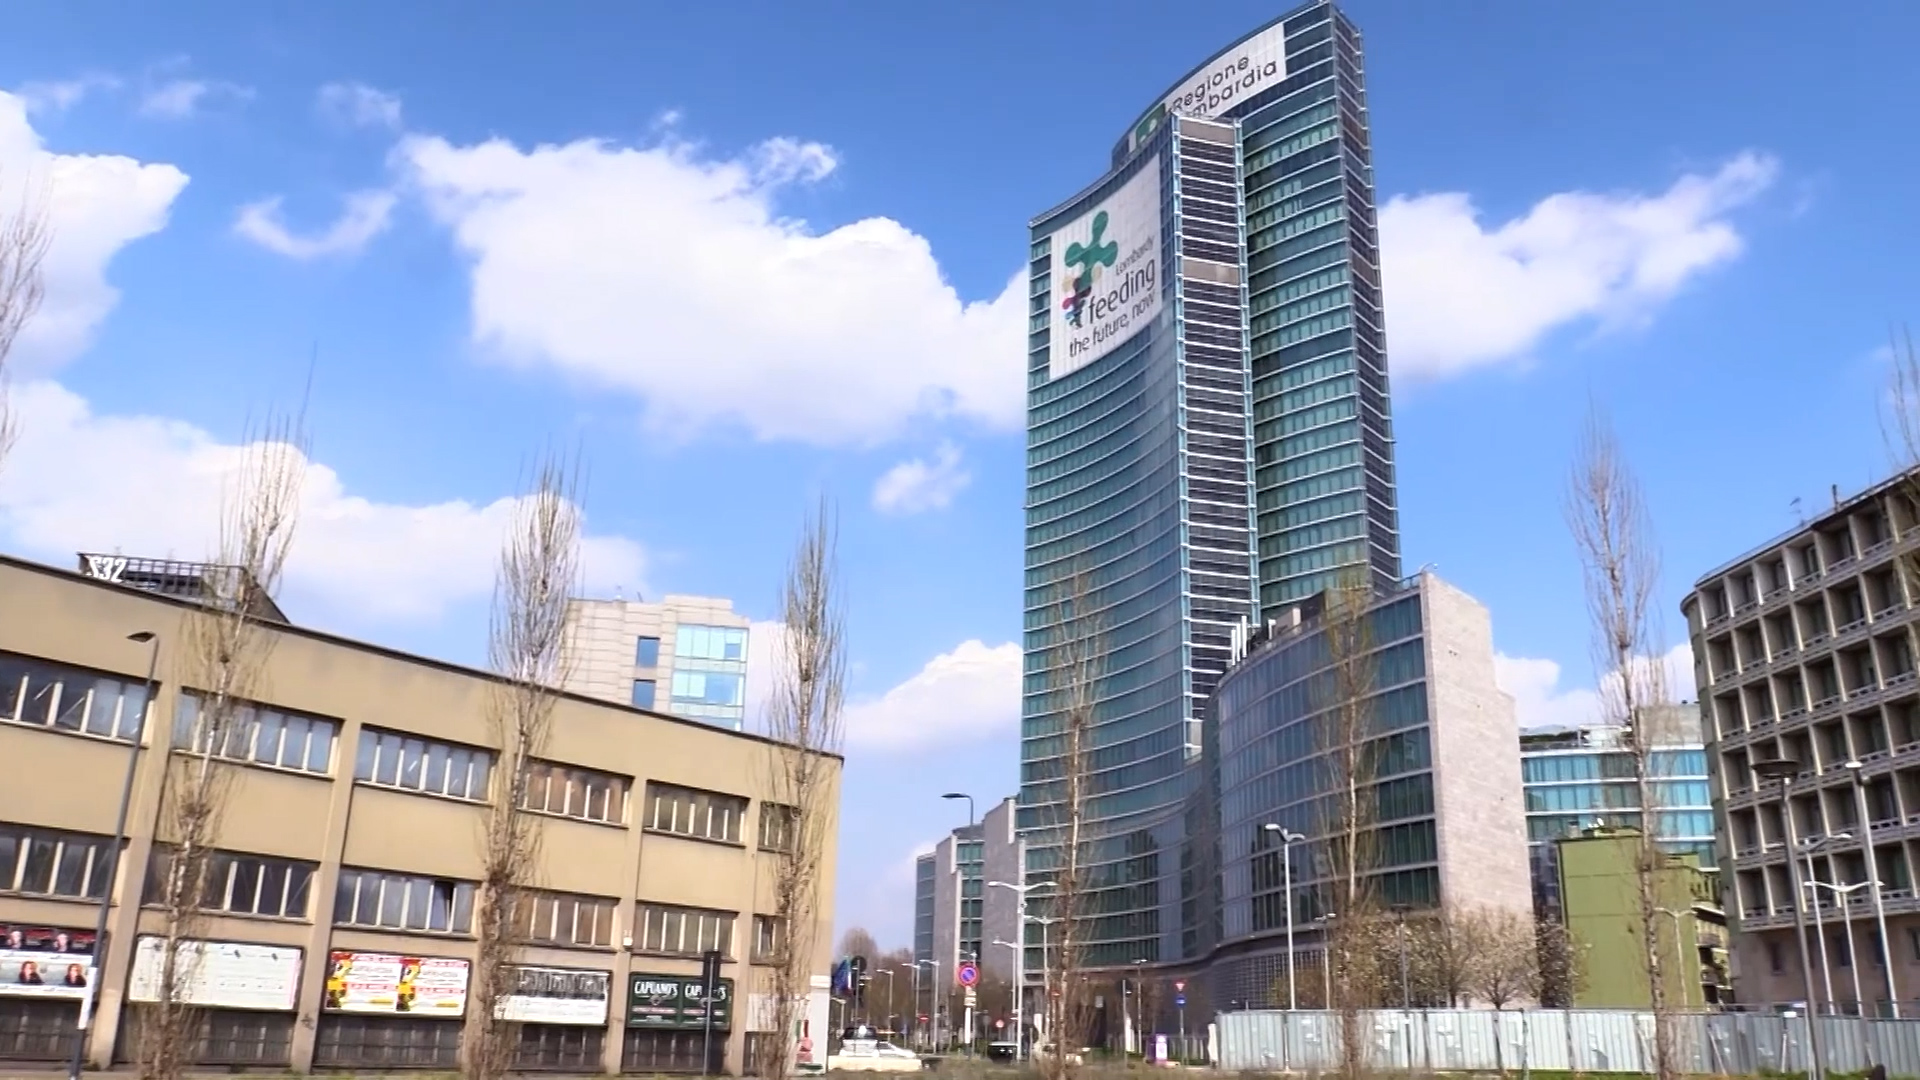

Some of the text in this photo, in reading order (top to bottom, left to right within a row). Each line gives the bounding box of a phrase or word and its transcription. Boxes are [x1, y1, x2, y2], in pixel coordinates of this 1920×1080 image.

[1172, 56, 1249, 111] Regione
[1186, 60, 1277, 118] mbardia
[1088, 258, 1155, 325] feeding
[1069, 337, 1090, 358] the
[1132, 289, 1156, 319] now
